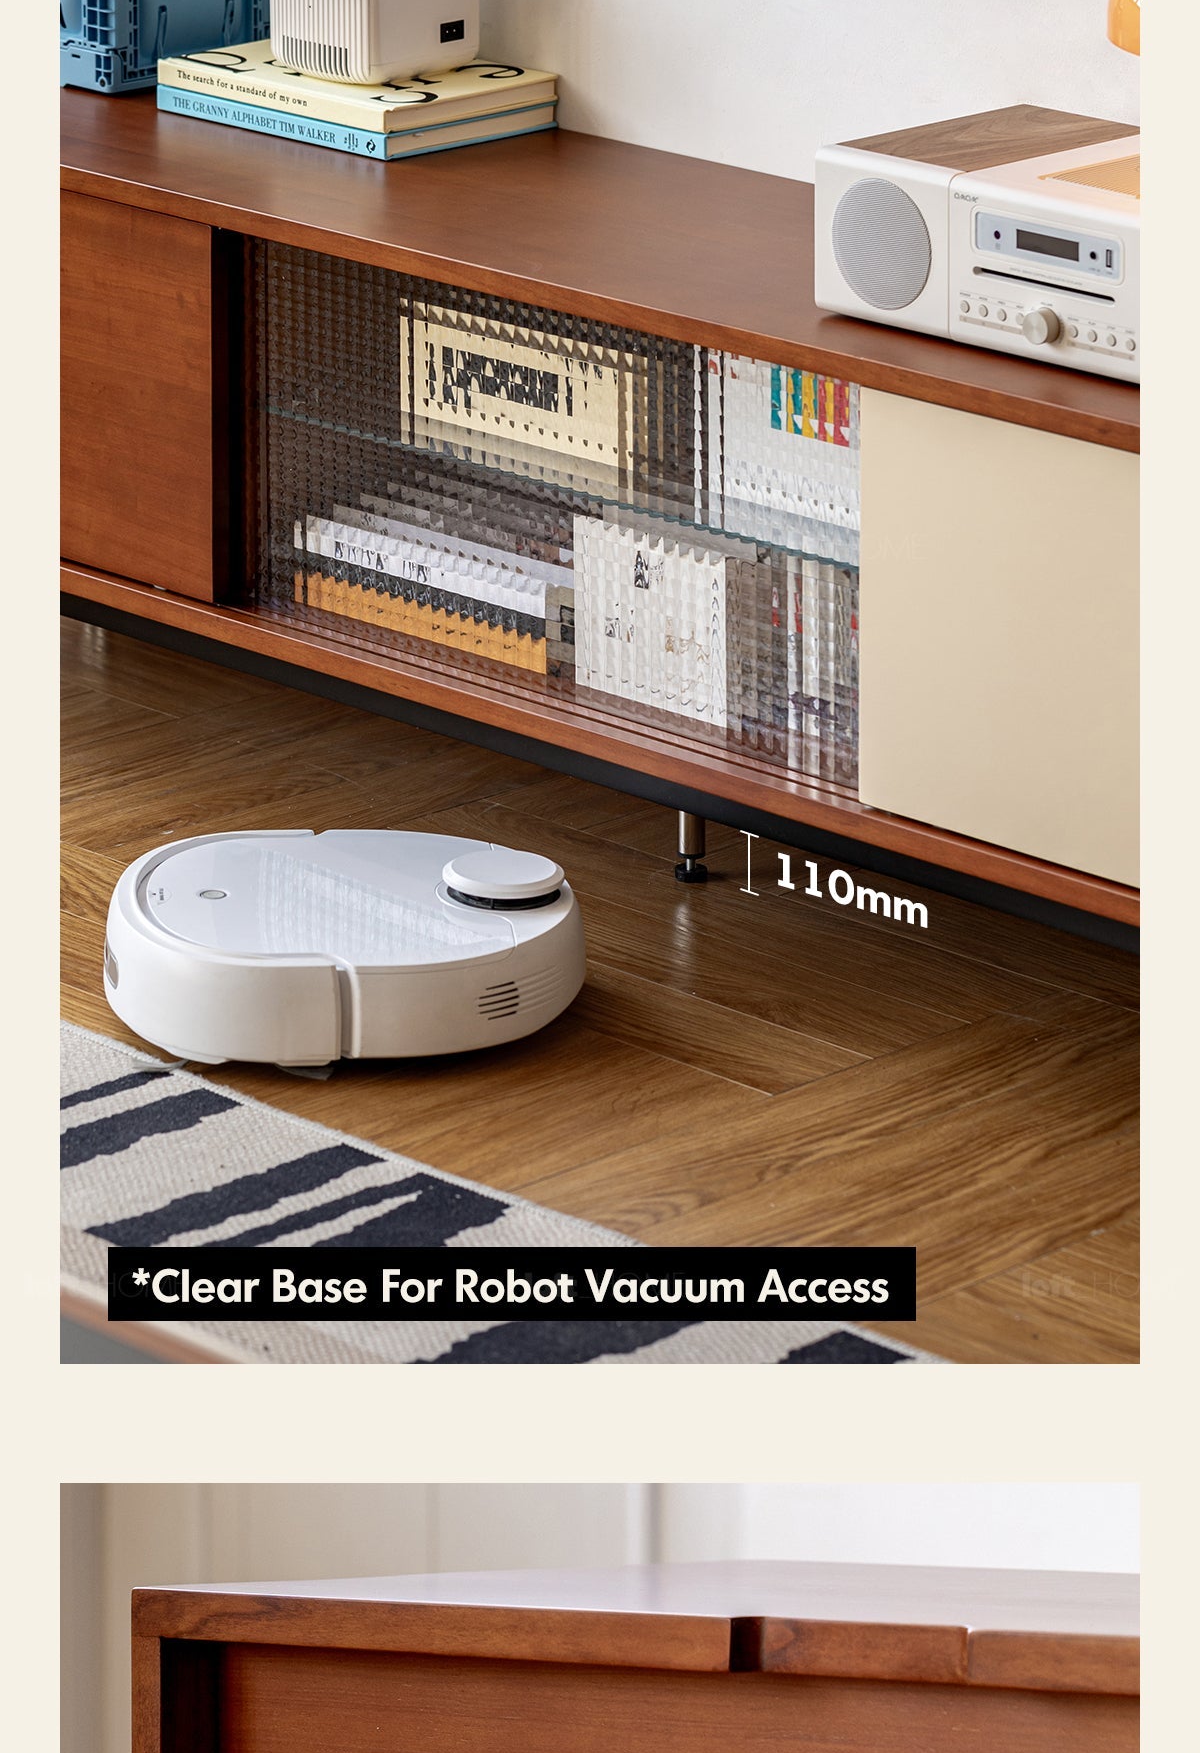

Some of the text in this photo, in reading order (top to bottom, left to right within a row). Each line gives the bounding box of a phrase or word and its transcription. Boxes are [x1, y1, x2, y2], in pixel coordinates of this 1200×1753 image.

[177, 70, 191, 81] The
[193, 74, 215, 86] search
[216, 78, 228, 89] for
[236, 84, 267, 98] standard
[269, 91, 277, 99] of
[279, 95, 290, 104] my
[292, 98, 308, 107] own
[173, 96, 191, 110] THE
[192, 101, 229, 119] GRANNY
[231, 111, 278, 130] ALPHABET
[279, 120, 295, 134] TIM
[297, 124, 336, 144] WALKER
